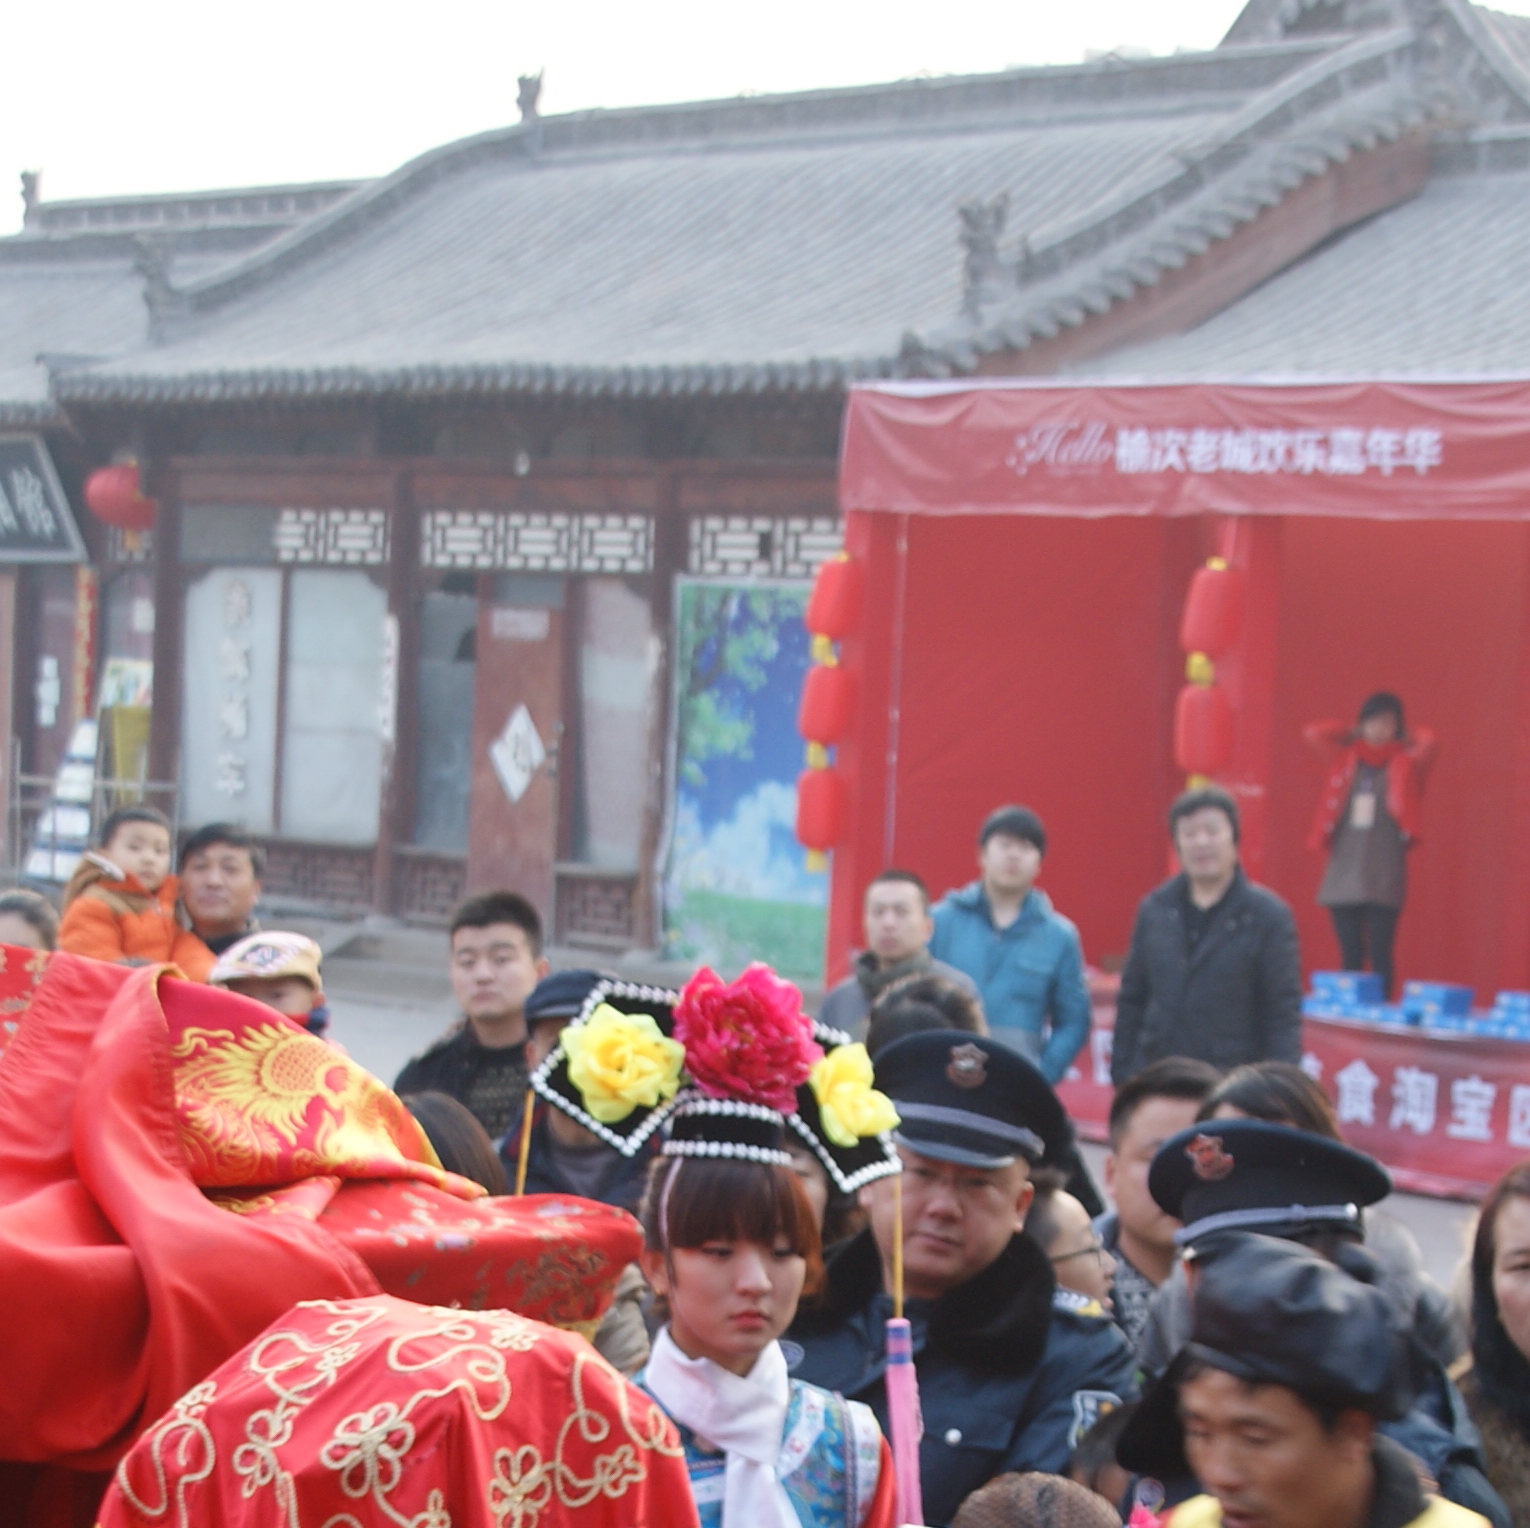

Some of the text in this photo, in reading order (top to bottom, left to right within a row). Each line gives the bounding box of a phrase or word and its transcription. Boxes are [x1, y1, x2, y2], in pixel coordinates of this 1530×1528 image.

[1114, 428, 1442, 475] 榆次老城欢乐嘉年华
